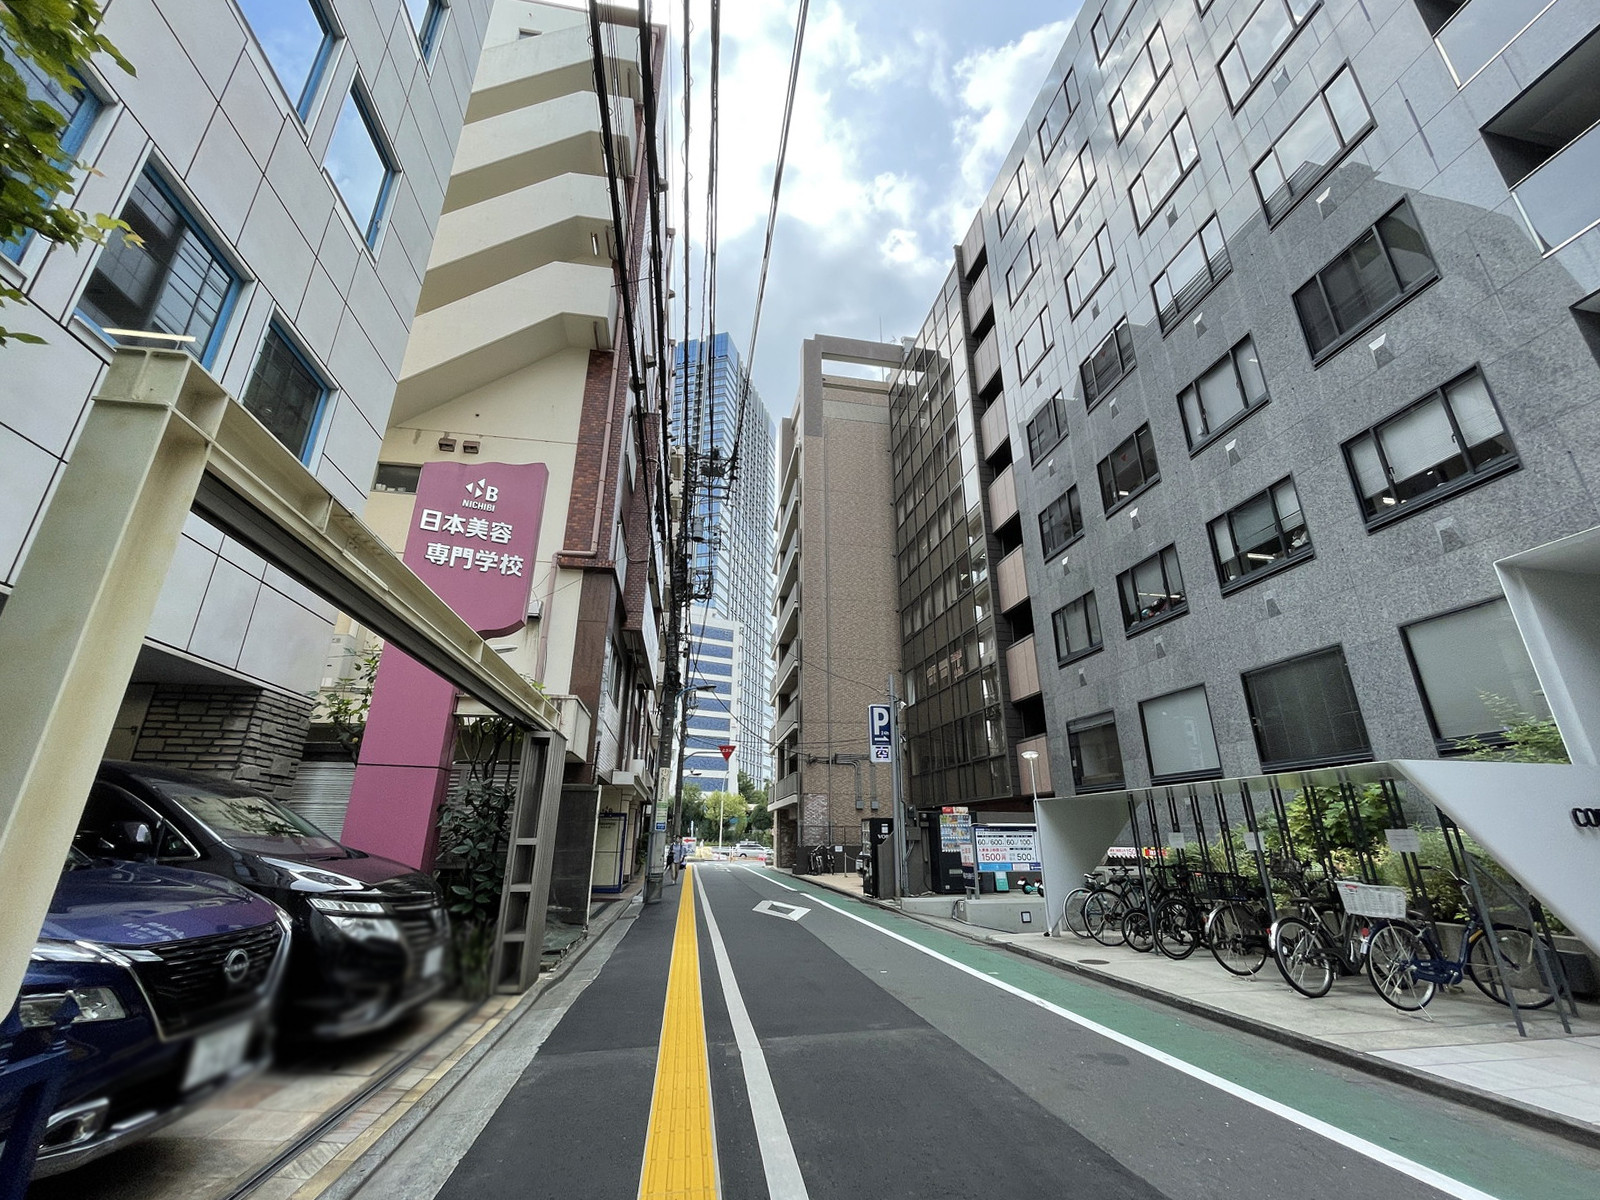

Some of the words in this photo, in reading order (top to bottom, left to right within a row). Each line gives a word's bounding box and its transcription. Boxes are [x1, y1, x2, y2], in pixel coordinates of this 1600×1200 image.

[462, 499, 496, 513] NICHIBI
[419, 508, 513, 544] 日本美容
[424, 542, 524, 577] 専門学校
[872, 707, 889, 735] P
[875, 746, 889, 759] 空
